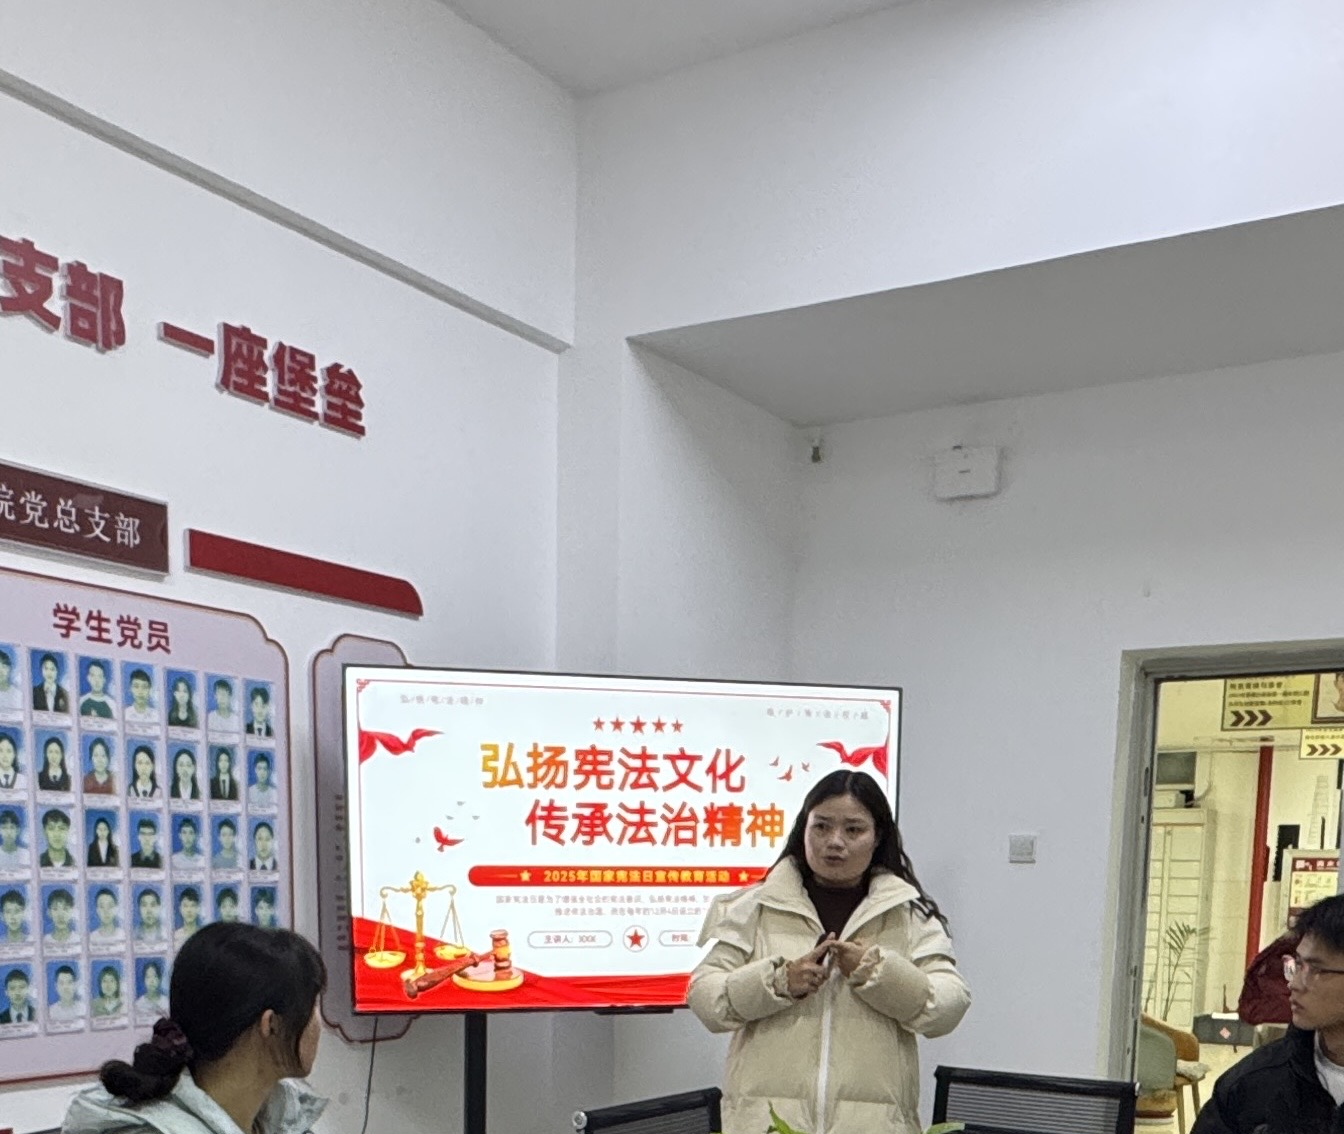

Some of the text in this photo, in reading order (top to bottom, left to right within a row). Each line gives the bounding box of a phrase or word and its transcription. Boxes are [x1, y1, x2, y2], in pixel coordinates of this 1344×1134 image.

[161, 321, 367, 437] 一座堡垒
[53, 602, 171, 654] 学生党员
[480, 742, 746, 793] 弘扬宪法文化
[525, 798, 785, 848] 传承法治精神
